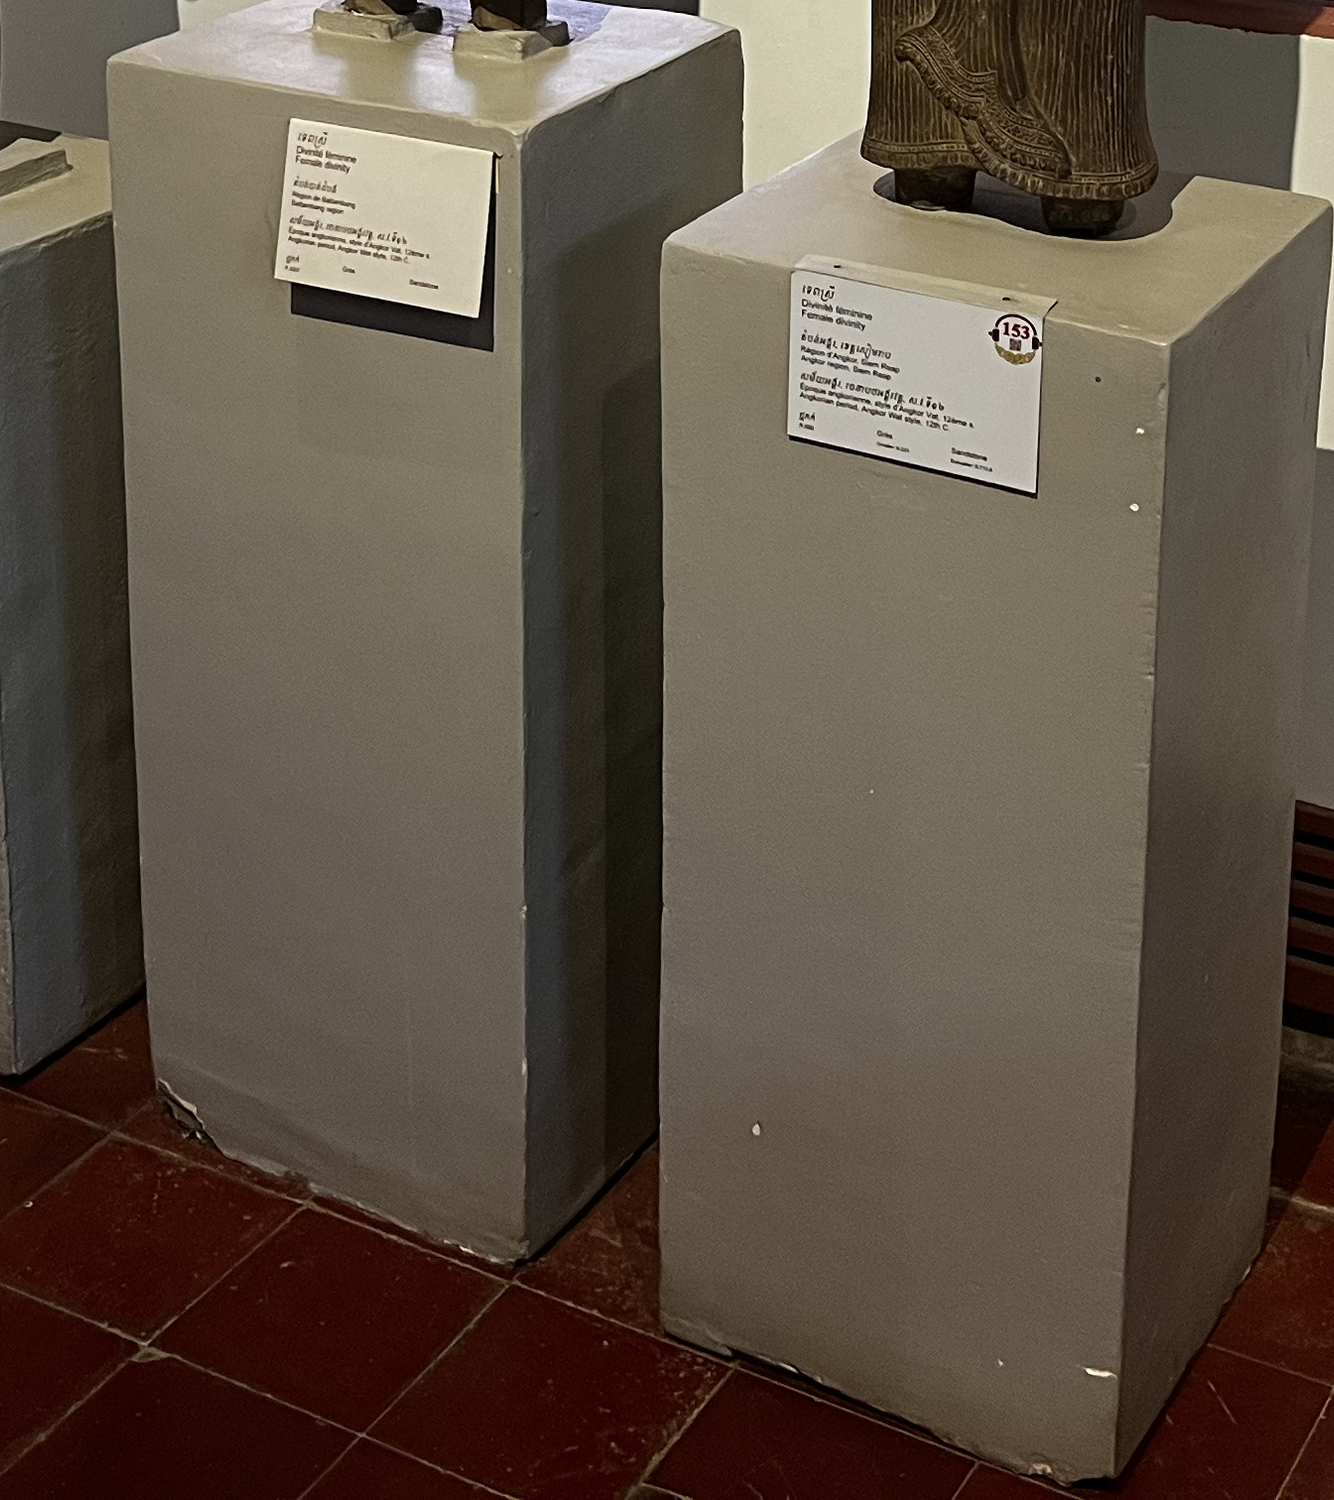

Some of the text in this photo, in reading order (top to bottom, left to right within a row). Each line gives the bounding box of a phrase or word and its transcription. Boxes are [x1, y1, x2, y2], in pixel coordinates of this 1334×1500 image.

[802, 309, 865, 331] Female divinity
[1003, 322, 1030, 339] 153
